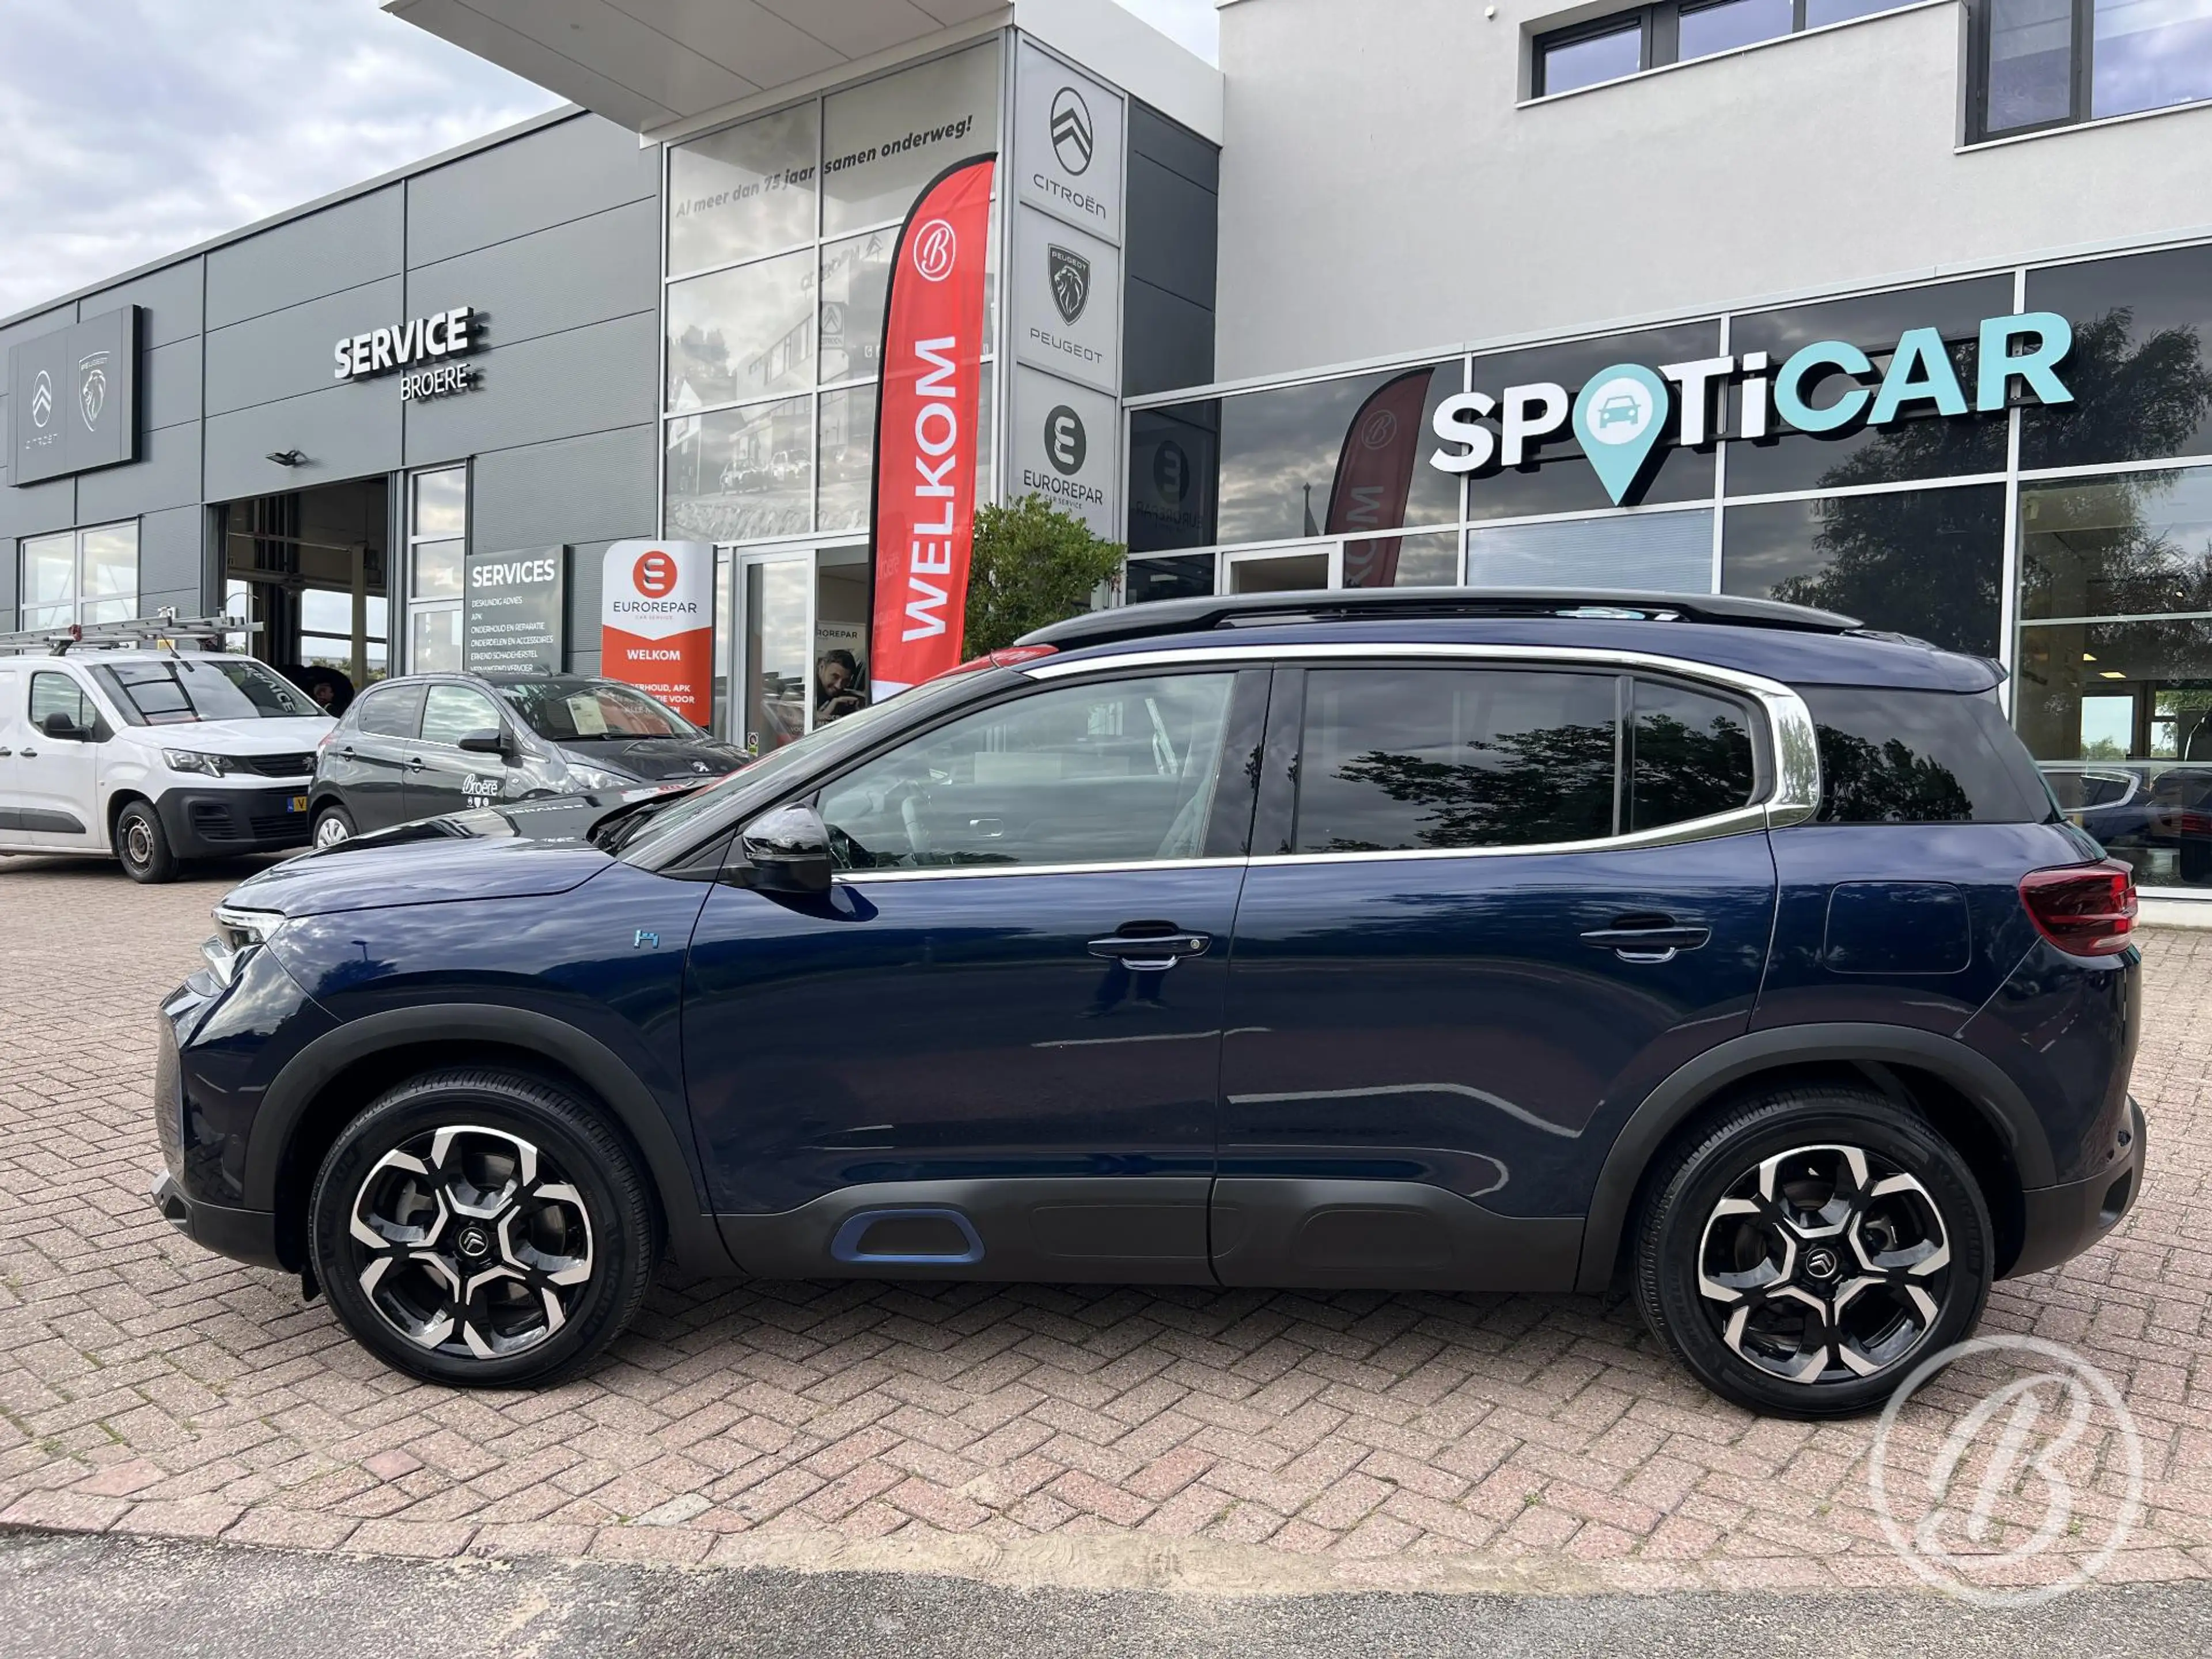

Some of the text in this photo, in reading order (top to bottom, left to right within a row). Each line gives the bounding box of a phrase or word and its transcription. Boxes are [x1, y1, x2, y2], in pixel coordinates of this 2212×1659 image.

[676, 115, 973, 218] Al meer dan 75 jaar samen onderweg!
[1033, 173, 1106, 219] CITROËN
[1052, 250, 1088, 272] PEUGEOT
[335, 306, 471, 379] SERVICE
[1031, 327, 1103, 364] PEUGEOT
[400, 363, 468, 402] BROERE
[902, 336, 958, 642] WELKOM
[1024, 469, 1103, 506] EUROREPAR
[472, 559, 555, 588] SERVICES
[613, 601, 698, 613] EUROREPAR
[627, 649, 680, 661] WELKOM
[669, 695, 696, 703] VOOR
[673, 684, 691, 692] APK
[460, 773, 498, 796] Broere
